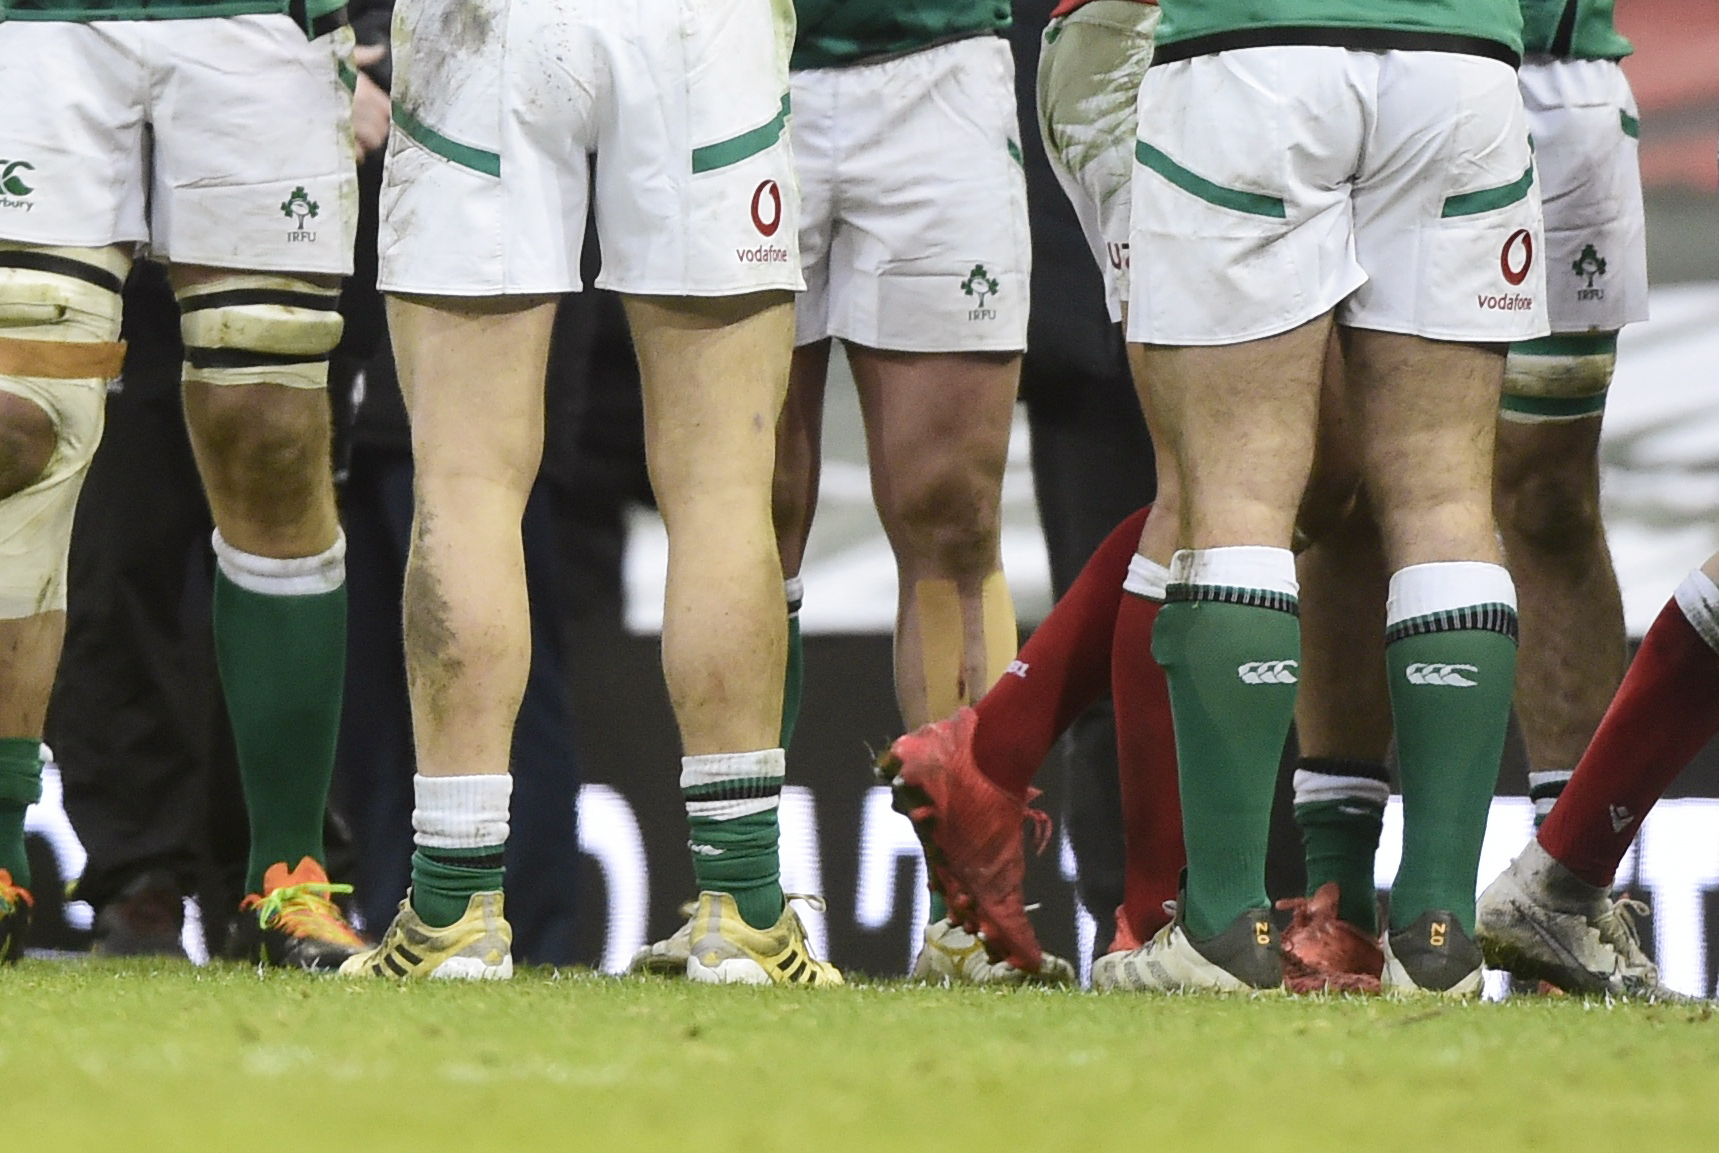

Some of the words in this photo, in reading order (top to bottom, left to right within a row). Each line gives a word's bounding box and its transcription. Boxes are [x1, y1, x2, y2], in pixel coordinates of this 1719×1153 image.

[287, 231, 317, 243] IRFU
[736, 244, 788, 263] vodafone
[1477, 293, 1533, 311] vodafone
[1576, 288, 1605, 302] IRFU
[968, 309, 997, 322] IRFU
